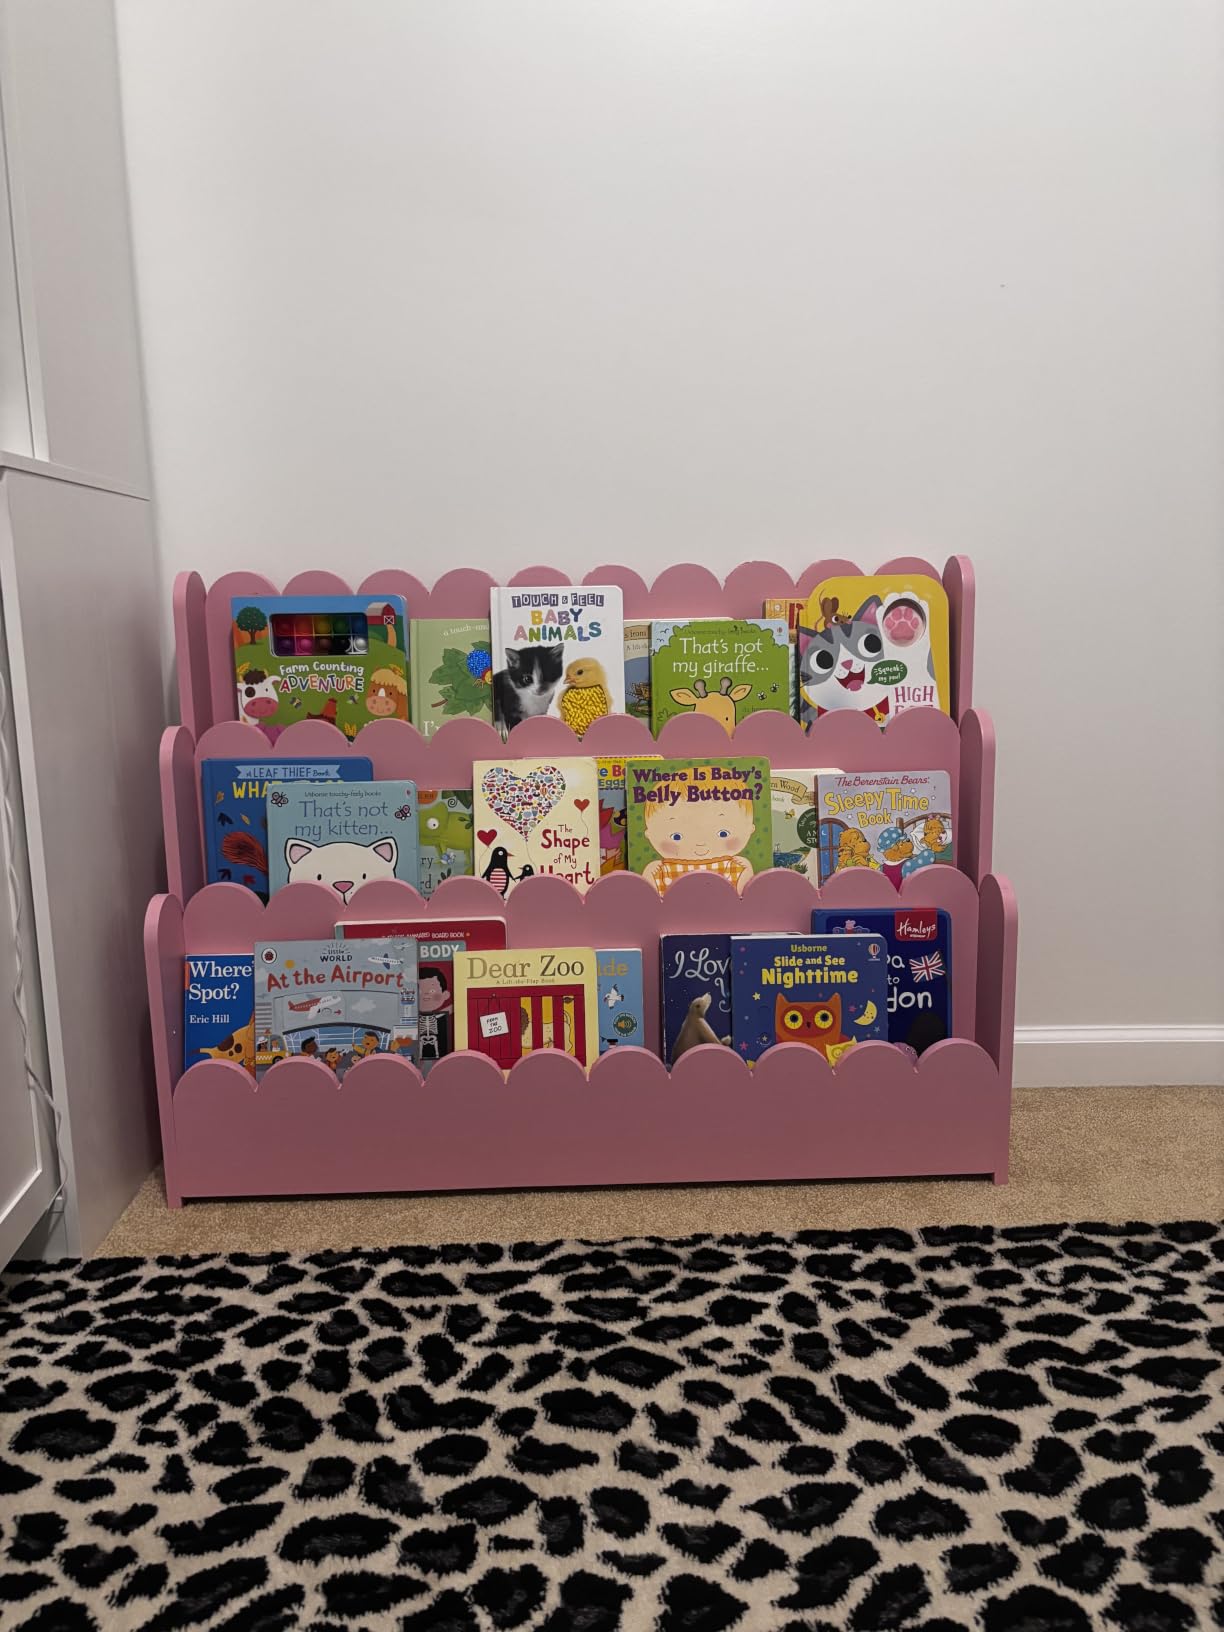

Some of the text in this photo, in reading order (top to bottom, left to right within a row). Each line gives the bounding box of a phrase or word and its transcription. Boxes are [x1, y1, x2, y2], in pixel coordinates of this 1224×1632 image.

[512, 593, 604, 608] TOUCH & FEEL
[531, 608, 583, 625] BABY
[513, 621, 602, 642] ANIMALS
[679, 636, 764, 654] That's not
[279, 661, 364, 676] Farm Counting
[673, 653, 769, 678] my giraffe...
[878, 663, 900, 675] Squeak
[279, 673, 365, 694] ADVENTURE
[894, 685, 935, 703] HIGH
[253, 767, 279, 778] LEAF
[281, 767, 312, 778] THIEF
[632, 767, 689, 783] Where
[693, 767, 707, 781] Is
[711, 766, 762, 783] Baby's
[834, 776, 852, 787] The
[853, 775, 899, 787] Berenstain
[633, 782, 763, 807] Belly Button?
[780, 779, 801, 793] Wood
[298, 799, 389, 818] That's not
[823, 787, 930, 816] Sleepy Time
[857, 807, 892, 829] Book
[295, 819, 393, 841] my kitten...
[558, 823, 573, 833] The
[541, 828, 590, 856] Shape
[553, 852, 577, 870] of My
[896, 917, 936, 938] Hamleys
[420, 944, 460, 959] BODY
[791, 944, 828, 953] Usborne
[320, 954, 353, 963] WORLD
[466, 954, 585, 979] Dear Zoo
[684, 947, 731, 982] Lov
[774, 954, 846, 967] Slide and See
[267, 963, 404, 992] At the Airport
[761, 966, 859, 989] Nighttime
[189, 982, 240, 1004] Spot?
[189, 1013, 230, 1024] Eric Hill
[488, 1026, 502, 1034] ZOO
